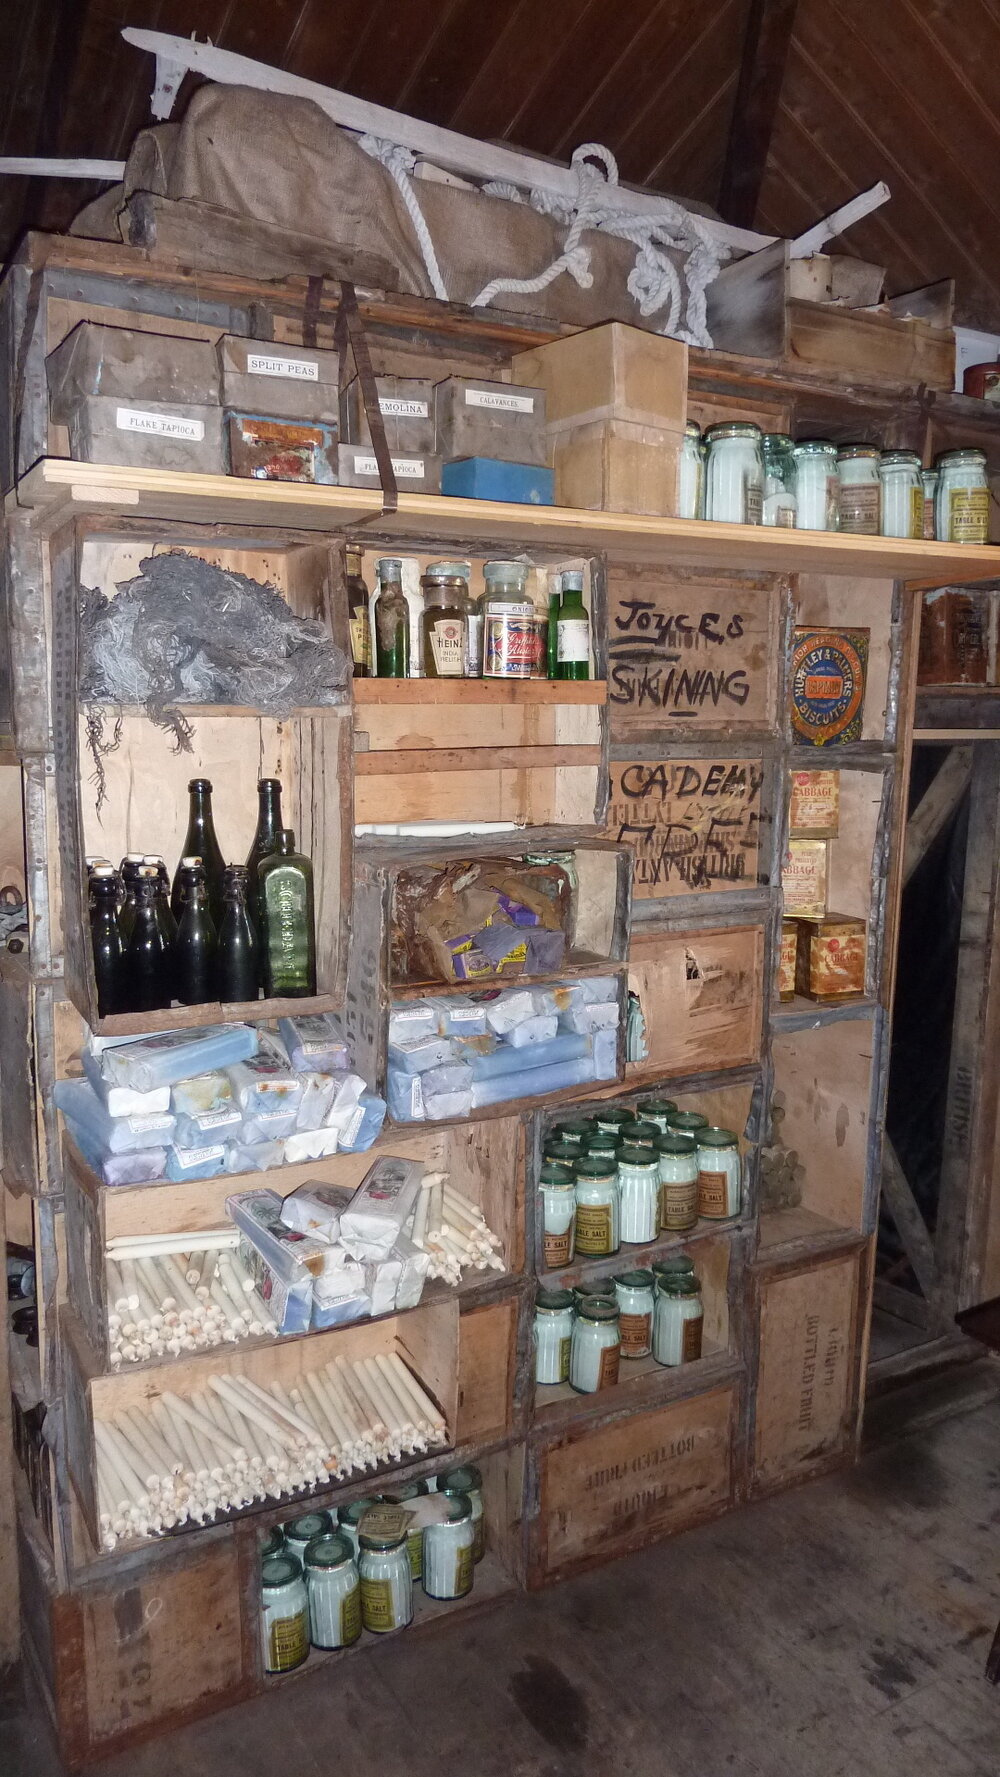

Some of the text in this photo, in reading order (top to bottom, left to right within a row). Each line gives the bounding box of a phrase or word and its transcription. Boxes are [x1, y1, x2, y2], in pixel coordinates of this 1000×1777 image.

[251, 359, 315, 376] SPLIT PEAS
[379, 402, 423, 414] EMOLINA
[130, 417, 196, 436] FLAKE TAPIOCA
[364, 463, 417, 473] FLA APIOCA
[955, 516, 974, 525] TABLE
[437, 636, 464, 648] HEINZ
[794, 648, 853, 697] HUNTLEY & PALMERS
[608, 763, 765, 803] CADEMY
[792, 787, 833, 797] CABBAGE
[782, 865, 817, 875] ABBAGE
[576, 1228, 607, 1238] ABLE SALT
[555, 1240, 568, 1248] SALT
[371, 1605, 387, 1613] SALT
